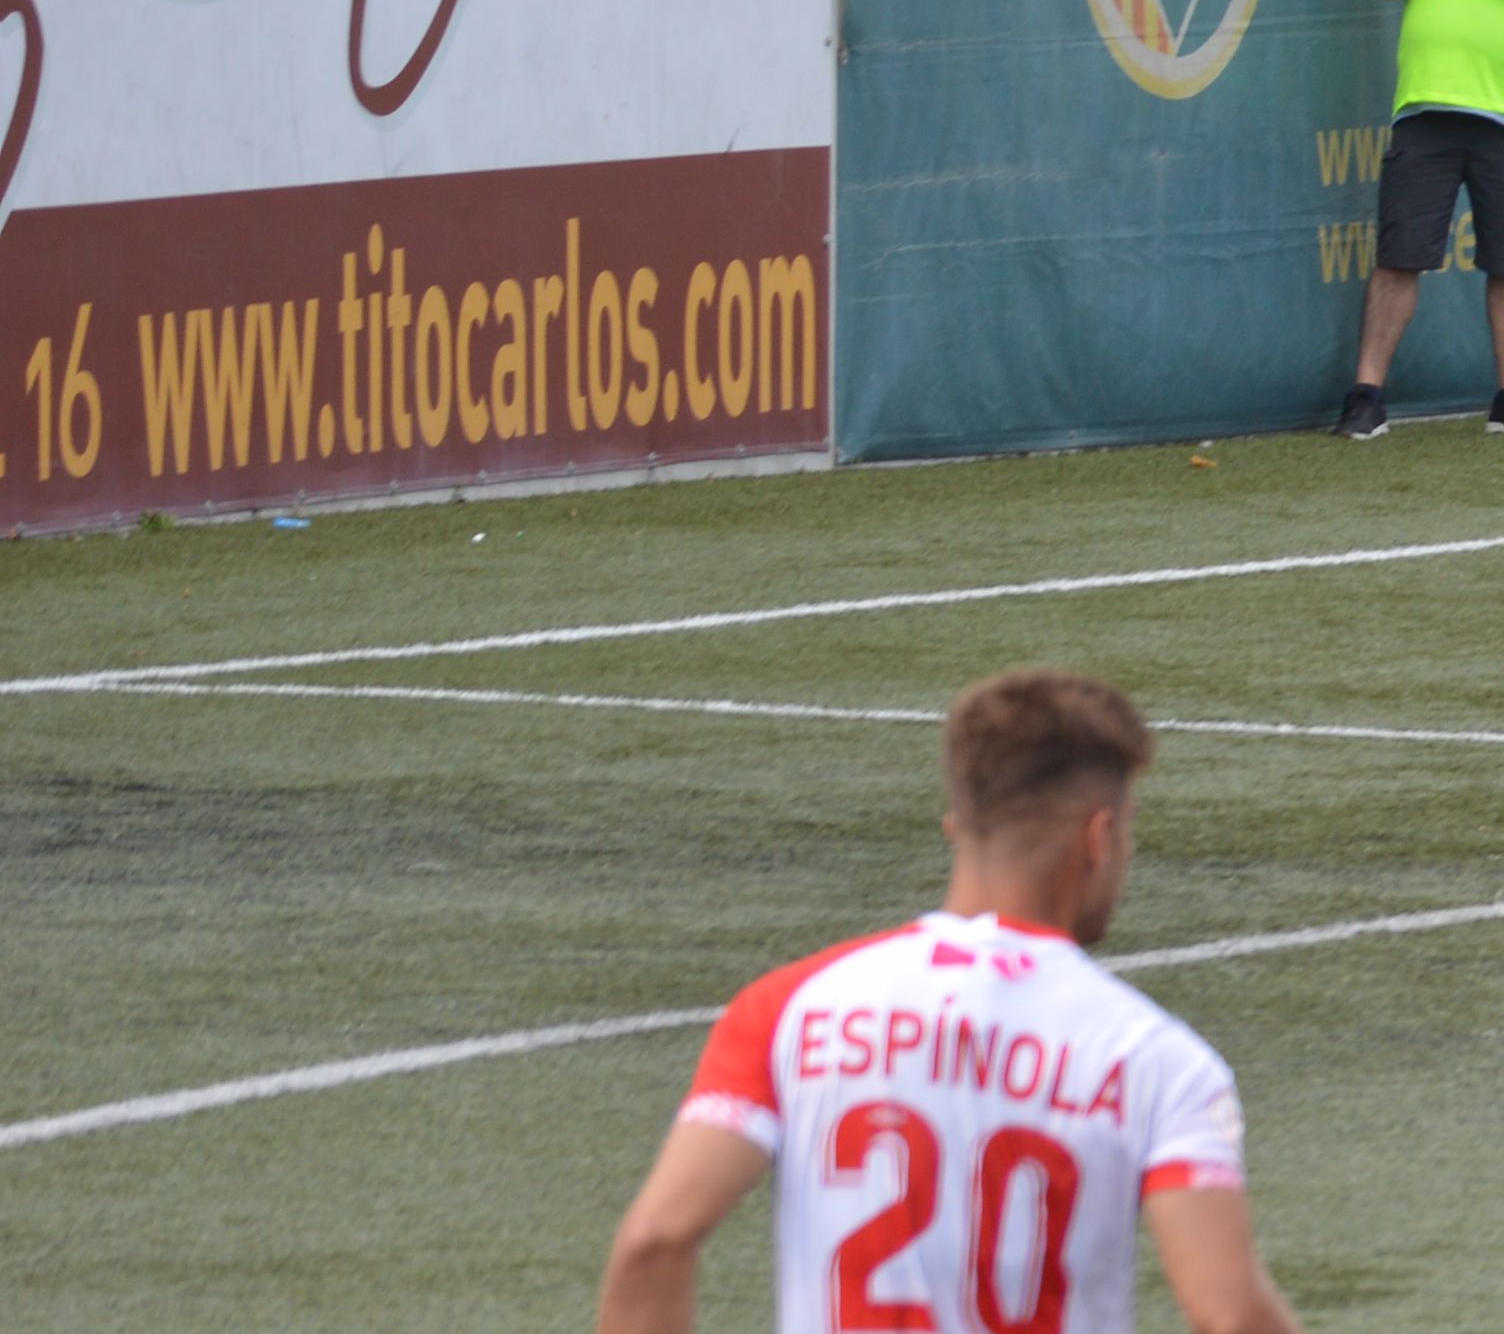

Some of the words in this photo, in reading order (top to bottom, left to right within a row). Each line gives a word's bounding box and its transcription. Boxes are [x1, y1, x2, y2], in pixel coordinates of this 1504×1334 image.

[26, 303, 102, 481] 16
[138, 217, 817, 478] www.titocarlos.com
[799, 995, 1129, 1127] ESPÍNOLA
